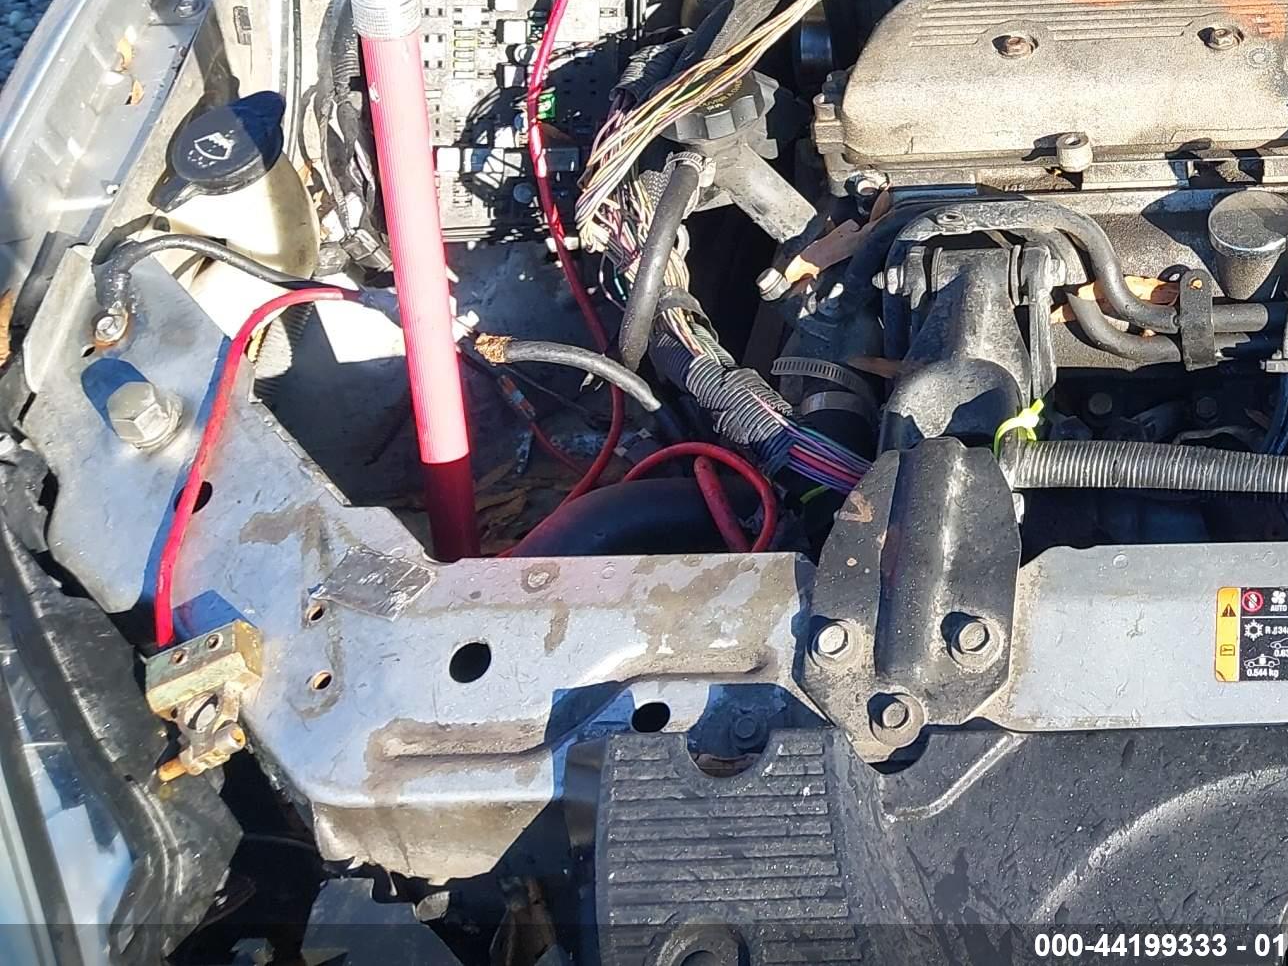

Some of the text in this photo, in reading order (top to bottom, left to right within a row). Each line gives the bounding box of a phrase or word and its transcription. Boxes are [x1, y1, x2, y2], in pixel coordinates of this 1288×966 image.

[1270, 604, 1288, 612] AUTO
[1246, 668, 1279, 678] 0.544 kg
